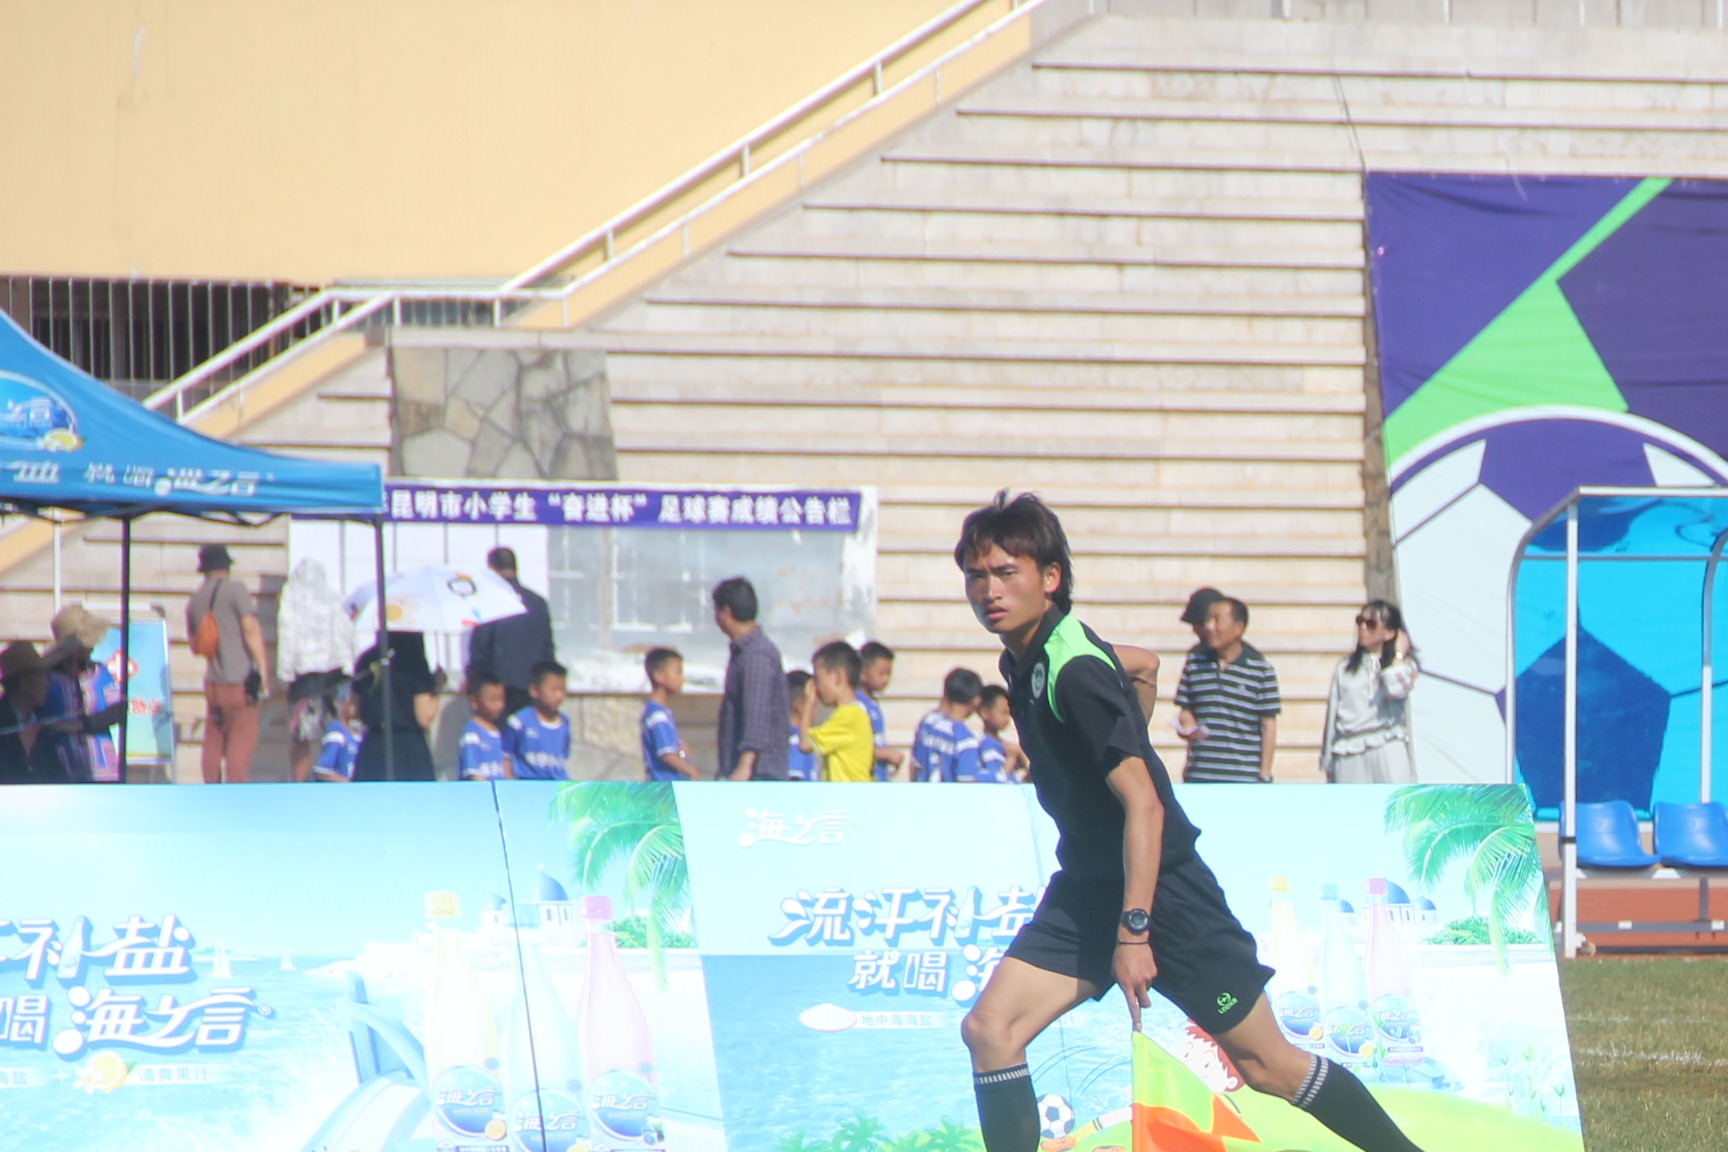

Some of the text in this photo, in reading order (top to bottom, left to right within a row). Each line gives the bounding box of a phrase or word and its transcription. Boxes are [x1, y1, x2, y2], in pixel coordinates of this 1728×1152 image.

[384, 489, 853, 526] 昆明市小学生“奋进杯”足球赛成绩公告栏
